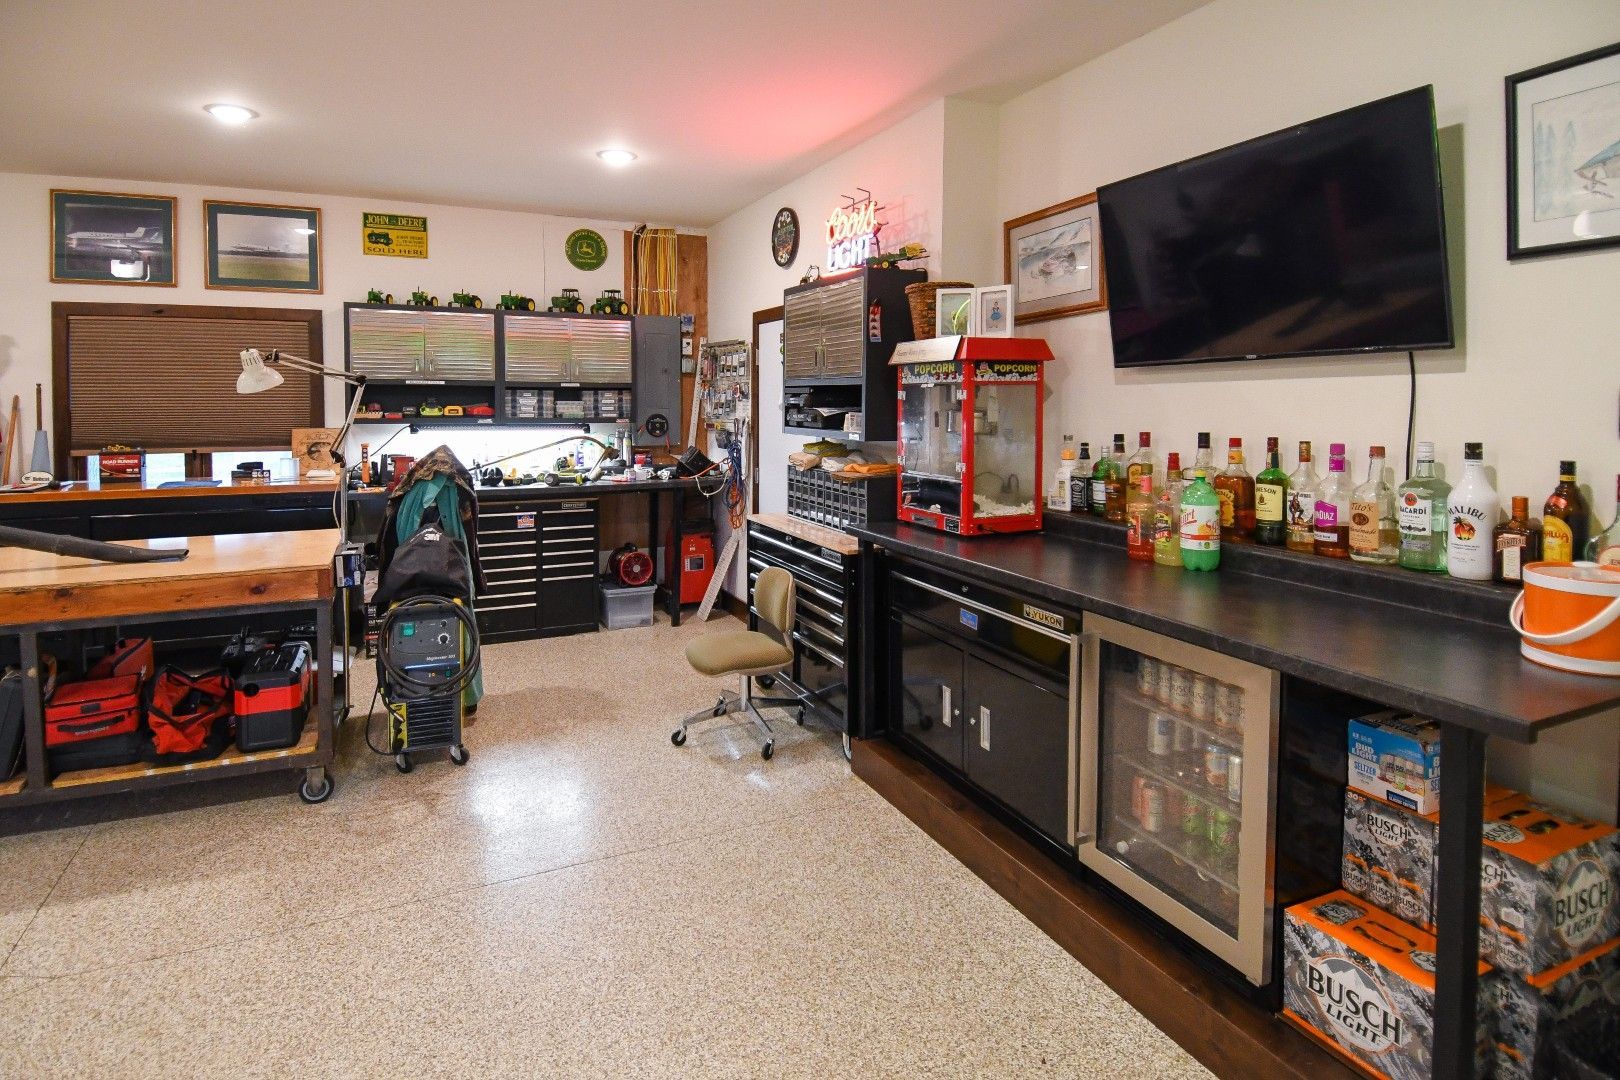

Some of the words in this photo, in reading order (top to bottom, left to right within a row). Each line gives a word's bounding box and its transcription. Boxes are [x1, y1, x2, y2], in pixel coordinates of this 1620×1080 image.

[367, 214, 389, 225] JOHN
[398, 217, 424, 227] DEERE
[826, 200, 877, 244] Coors
[367, 246, 396, 254] SOLD
[399, 248, 425, 256] HERE
[914, 362, 955, 375] POPCORN
[994, 364, 1037, 372] POPCORN
[1448, 505, 1487, 522] MALIBU
[424, 533, 440, 541] 3M
[1155, 530, 1169, 539] MIX
[1033, 610, 1062, 627] YUKON
[1351, 747, 1378, 763] LIGHT
[1355, 742, 1375, 754] BUD
[1353, 761, 1377, 776] SELTZER
[1367, 814, 1409, 840] BUSCH
[1375, 828, 1399, 842] LIGHT
[1346, 871, 1369, 888] BUSCH
[1371, 884, 1395, 900] BUSCH
[1400, 896, 1422, 913] BUSCH
[1555, 879, 1610, 929] BUSCH
[1566, 912, 1599, 938] LIGHT
[1308, 965, 1402, 1045] BUSCH
[1326, 1003, 1381, 1043] LIGHT
